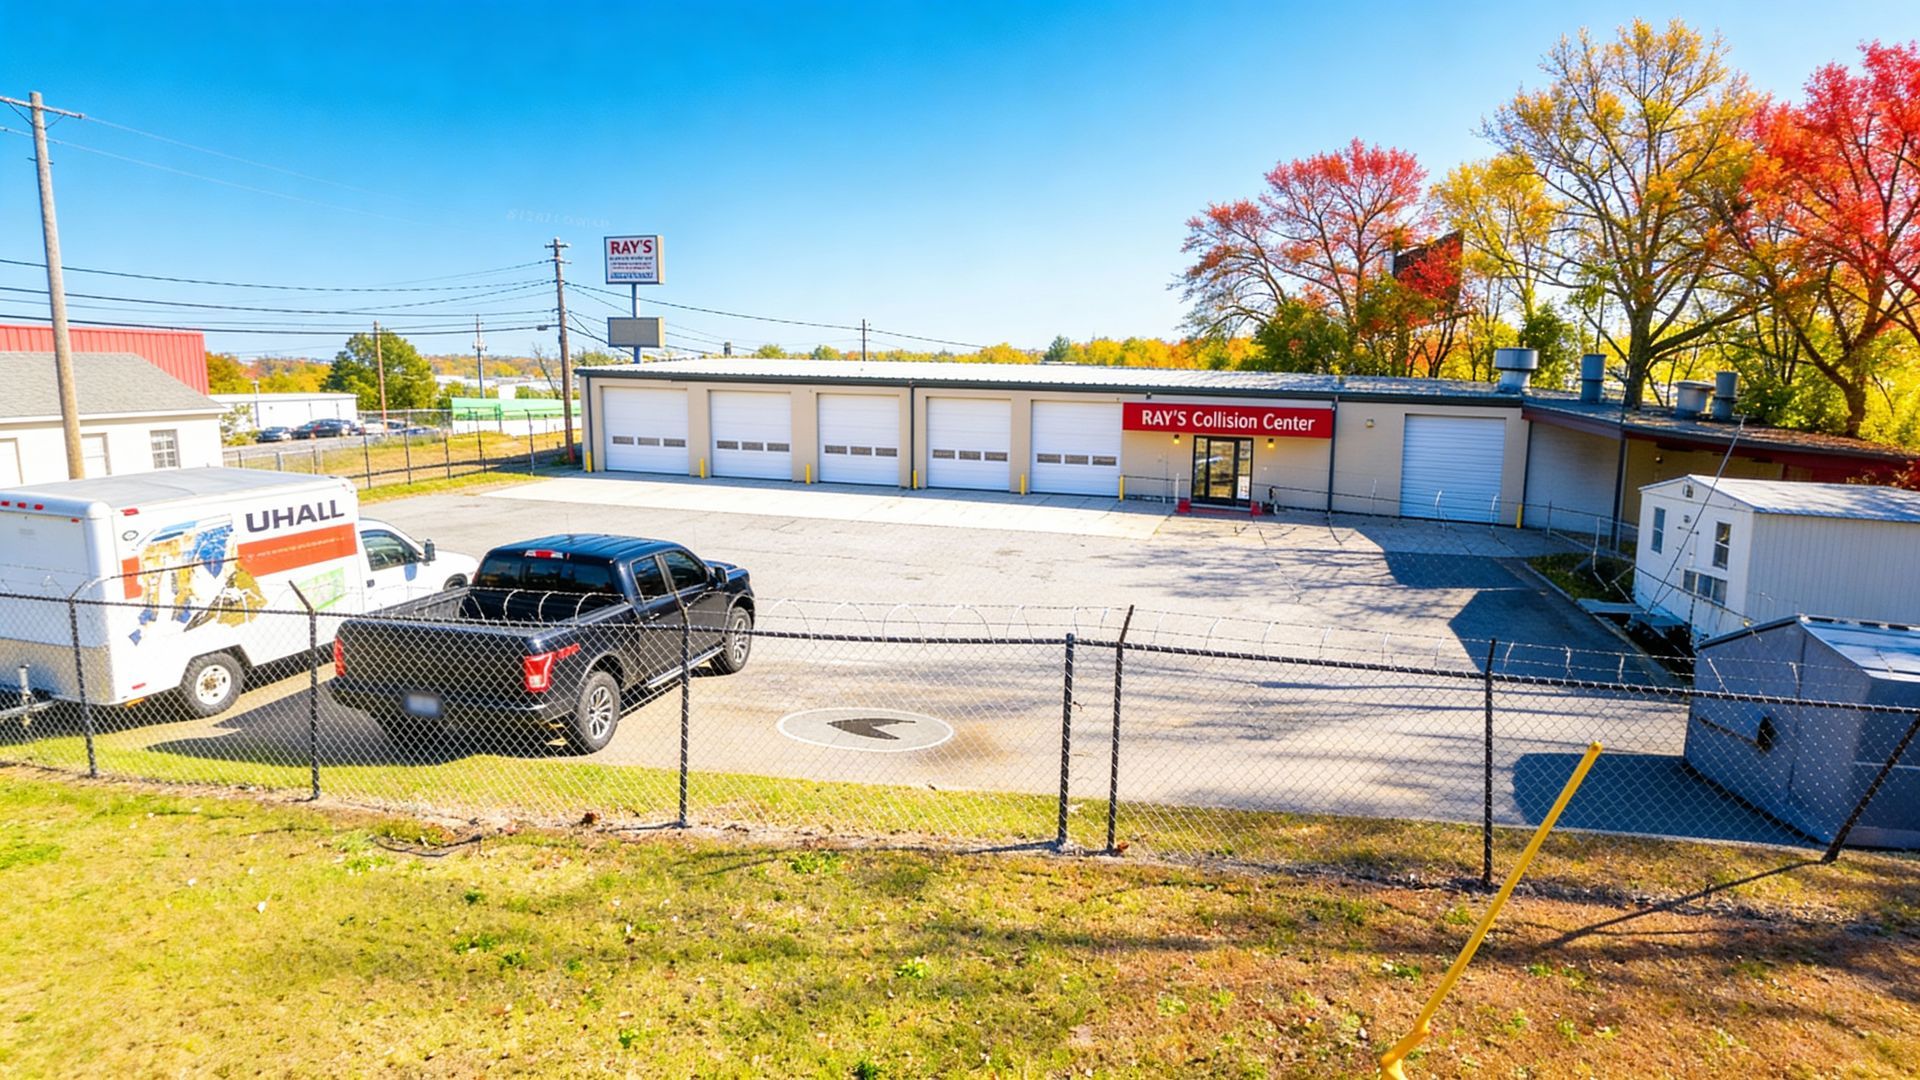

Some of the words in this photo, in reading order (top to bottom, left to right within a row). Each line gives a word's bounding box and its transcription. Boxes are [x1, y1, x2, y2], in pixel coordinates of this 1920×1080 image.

[610, 240, 652, 255] RAY'S
[1141, 409, 1186, 427] RAY'S
[1192, 411, 1257, 430] Collision
[1263, 413, 1315, 432] Center
[246, 500, 345, 533] UHALL
